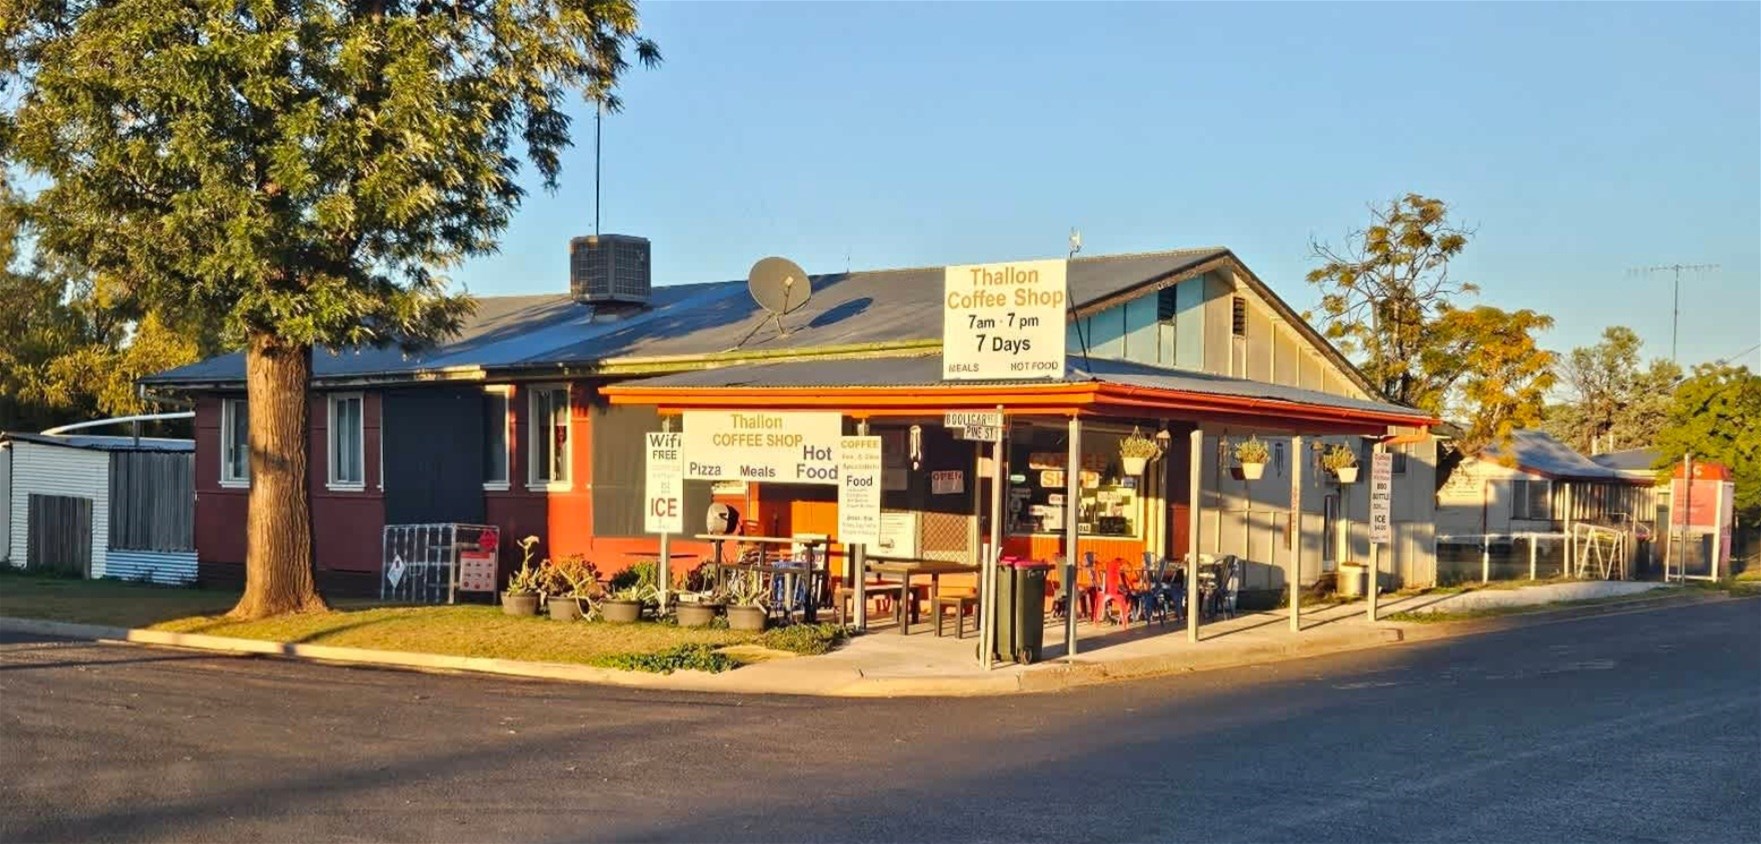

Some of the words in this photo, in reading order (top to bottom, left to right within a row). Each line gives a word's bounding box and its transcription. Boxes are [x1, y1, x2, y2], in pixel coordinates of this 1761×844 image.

[970, 266, 1039, 286] Thallon
[947, 290, 1007, 309] Coffee
[1014, 288, 1064, 308] Shop
[968, 314, 995, 329] 7am
[1007, 312, 1016, 327] 7
[1019, 316, 1039, 330] pm
[976, 334, 986, 352] 7
[992, 336, 1031, 355] Days
[948, 363, 979, 373] MEALS
[1010, 362, 1029, 371] HOT
[1031, 360, 1059, 370] FOOD
[730, 413, 783, 430] Thallon
[649, 433, 682, 449] Wifi
[712, 433, 763, 447] COFFEE
[766, 434, 803, 448] SHOP
[985, 427, 993, 439] ST
[841, 439, 880, 449] COFFEE
[652, 449, 678, 460] FREE
[803, 445, 832, 461] Hot
[689, 461, 722, 476] Pizza
[739, 464, 776, 478] Meals
[796, 463, 839, 480] Food
[846, 474, 873, 487] Food
[650, 498, 678, 517] ICE
[1374, 515, 1387, 524] ICE
